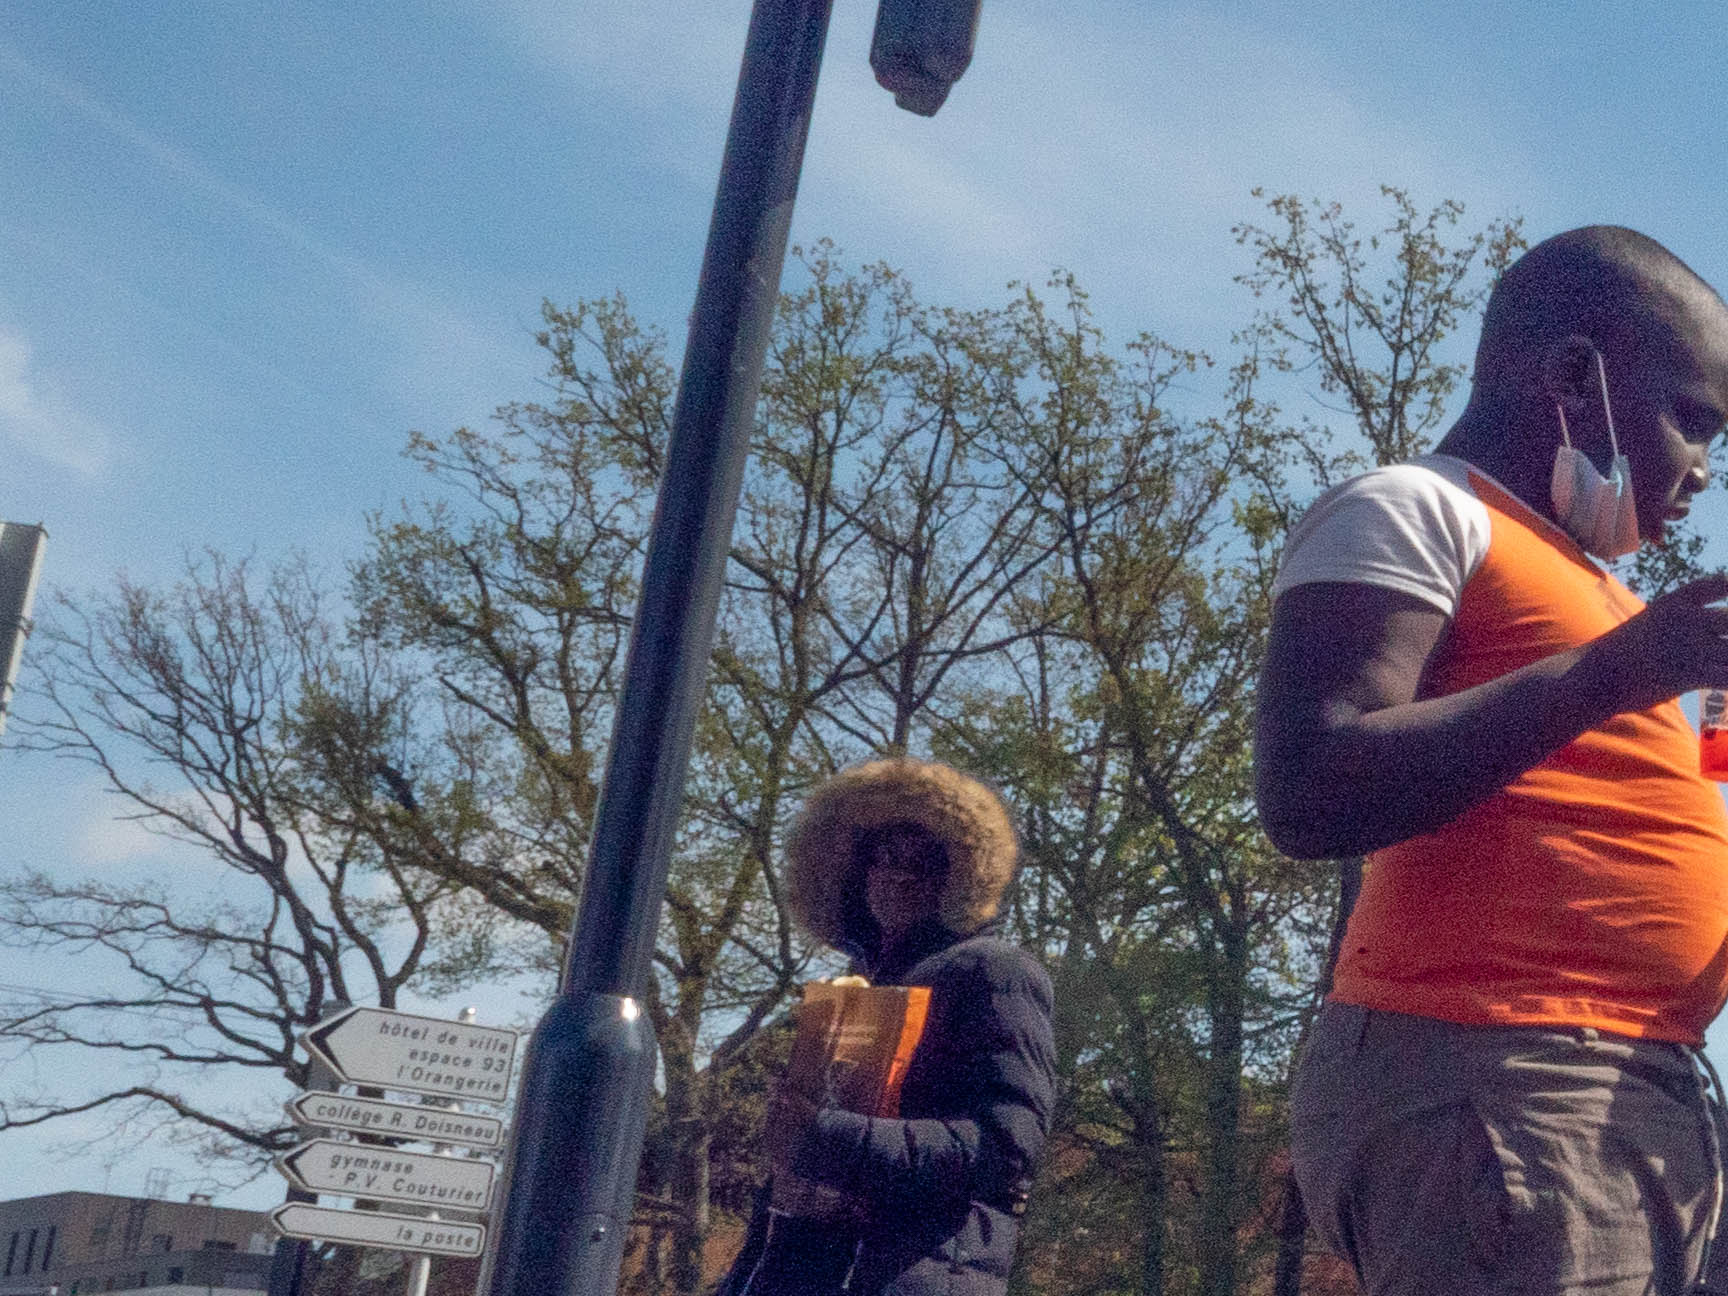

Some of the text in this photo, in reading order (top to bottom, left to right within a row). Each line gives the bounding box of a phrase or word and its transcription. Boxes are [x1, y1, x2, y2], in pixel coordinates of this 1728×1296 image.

[380, 1021, 508, 1054] hôtel de ville
[409, 1048, 506, 1073] espace 93
[397, 1065, 501, 1092] l'Orangerie
[317, 1105, 495, 1139] collège R. Doisneau
[331, 1154, 414, 1173] gymnase
[344, 1172, 381, 1189] P.V.
[393, 1179, 483, 1202] Couturier
[396, 1224, 474, 1247] la poste
